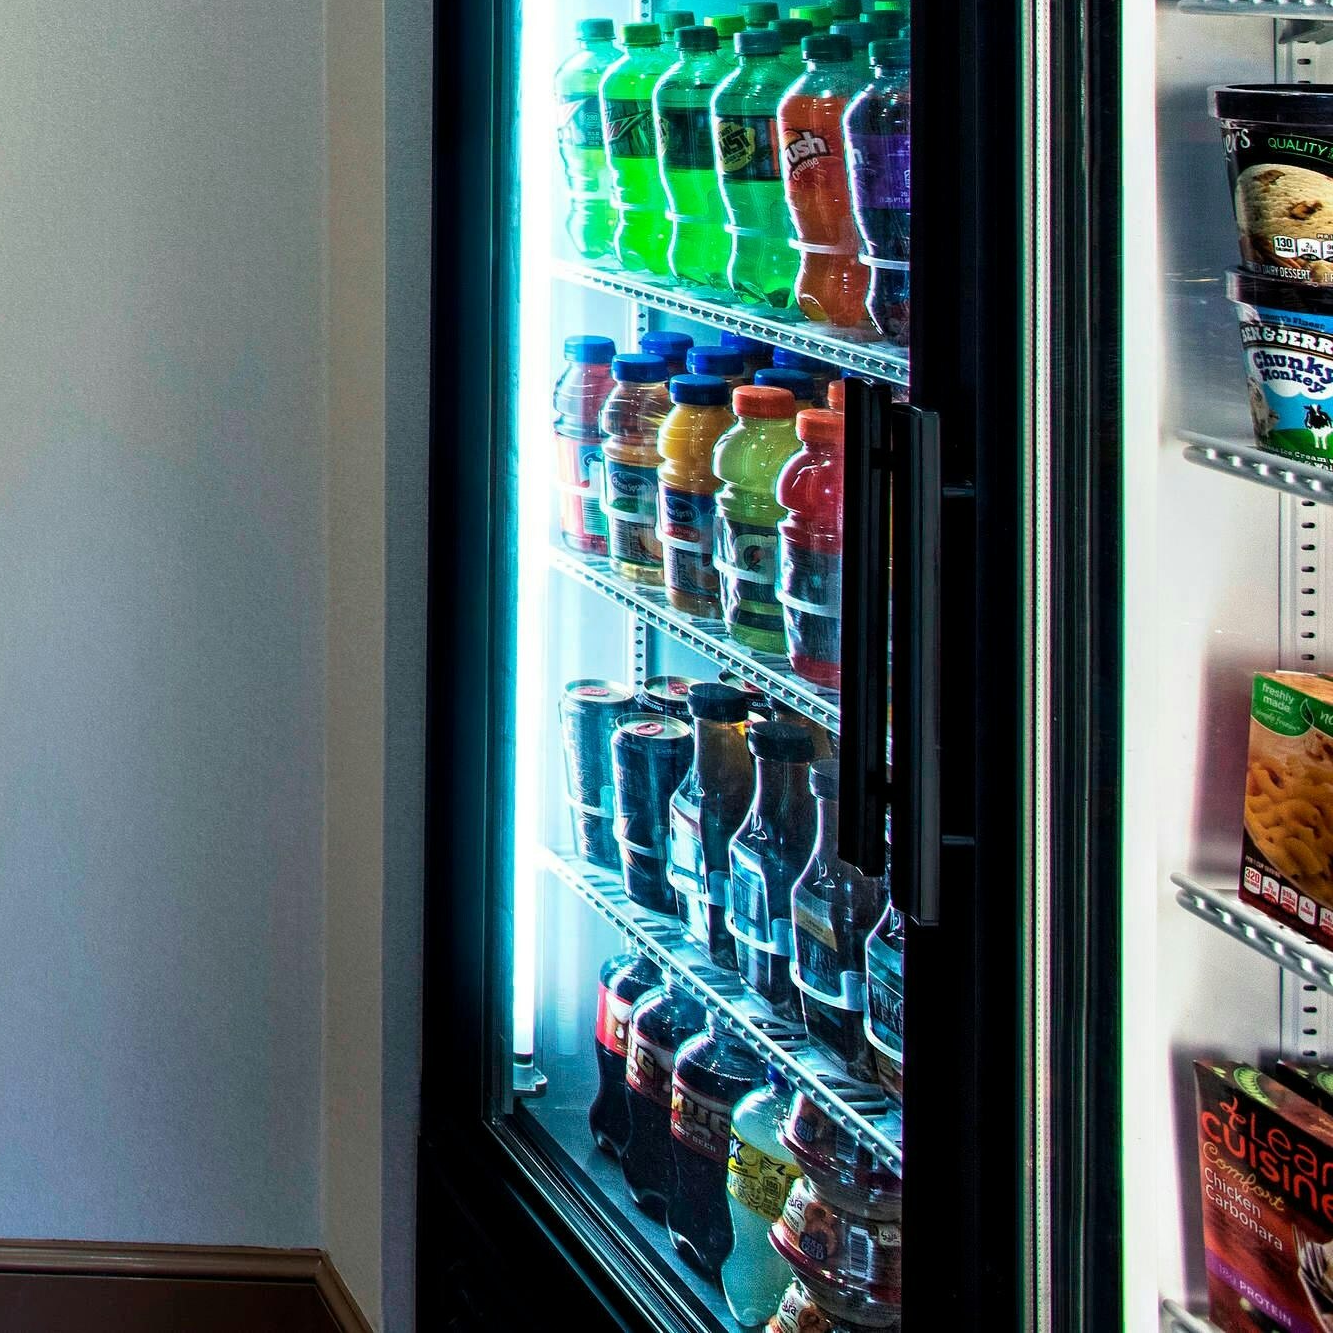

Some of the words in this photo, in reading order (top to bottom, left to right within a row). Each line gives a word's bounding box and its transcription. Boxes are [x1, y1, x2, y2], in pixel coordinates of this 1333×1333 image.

[1267, 138, 1328, 155] QUALITY
[1241, 327, 1261, 344] BEN
[1260, 368, 1326, 393] Monkey
[1262, 683, 1294, 704] freshly
[1263, 695, 1290, 713] made
[1203, 1142, 1285, 1210] Comfort
[1204, 1167, 1261, 1218] Chicken
[1205, 1185, 1283, 1251] Carbonara
[1239, 1280, 1292, 1327] PROTEIN
